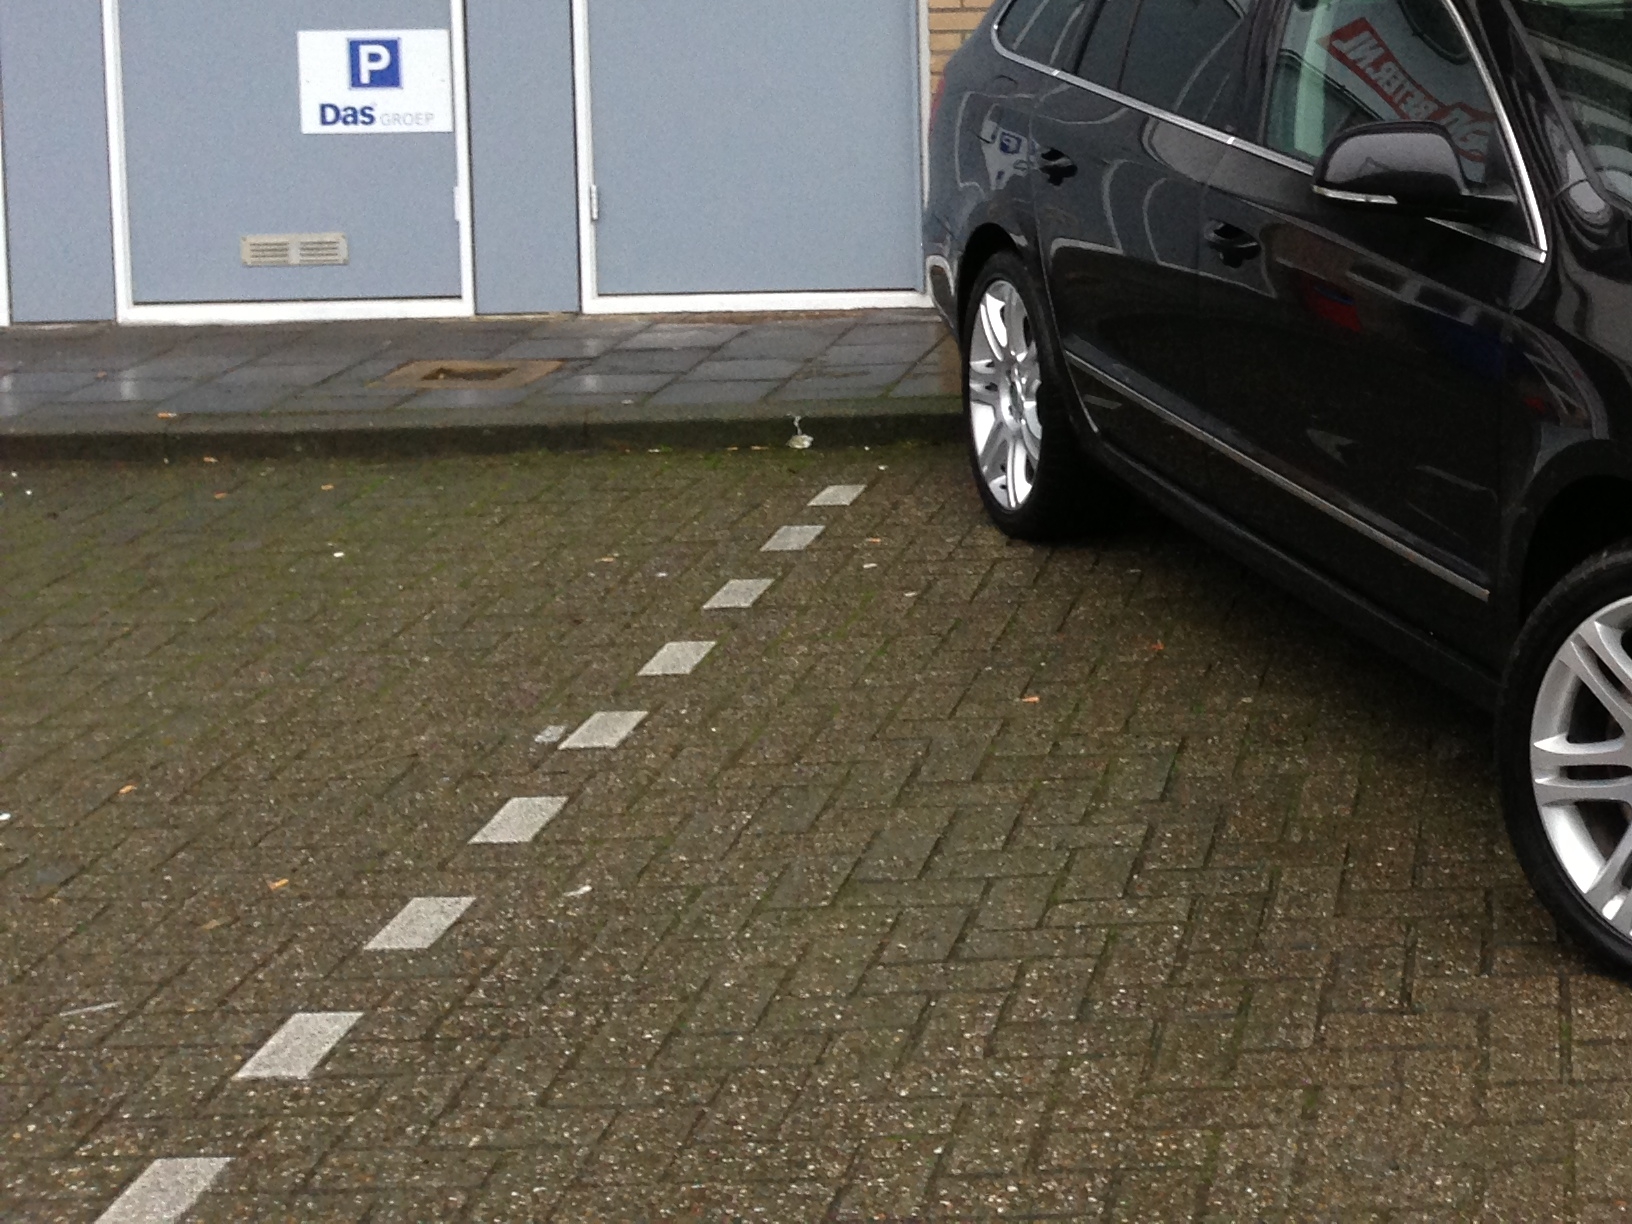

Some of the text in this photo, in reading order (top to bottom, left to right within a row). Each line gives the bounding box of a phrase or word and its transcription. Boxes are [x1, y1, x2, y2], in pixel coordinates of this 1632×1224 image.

[358, 44, 392, 84] P
[319, 103, 435, 126] Das GROEP
